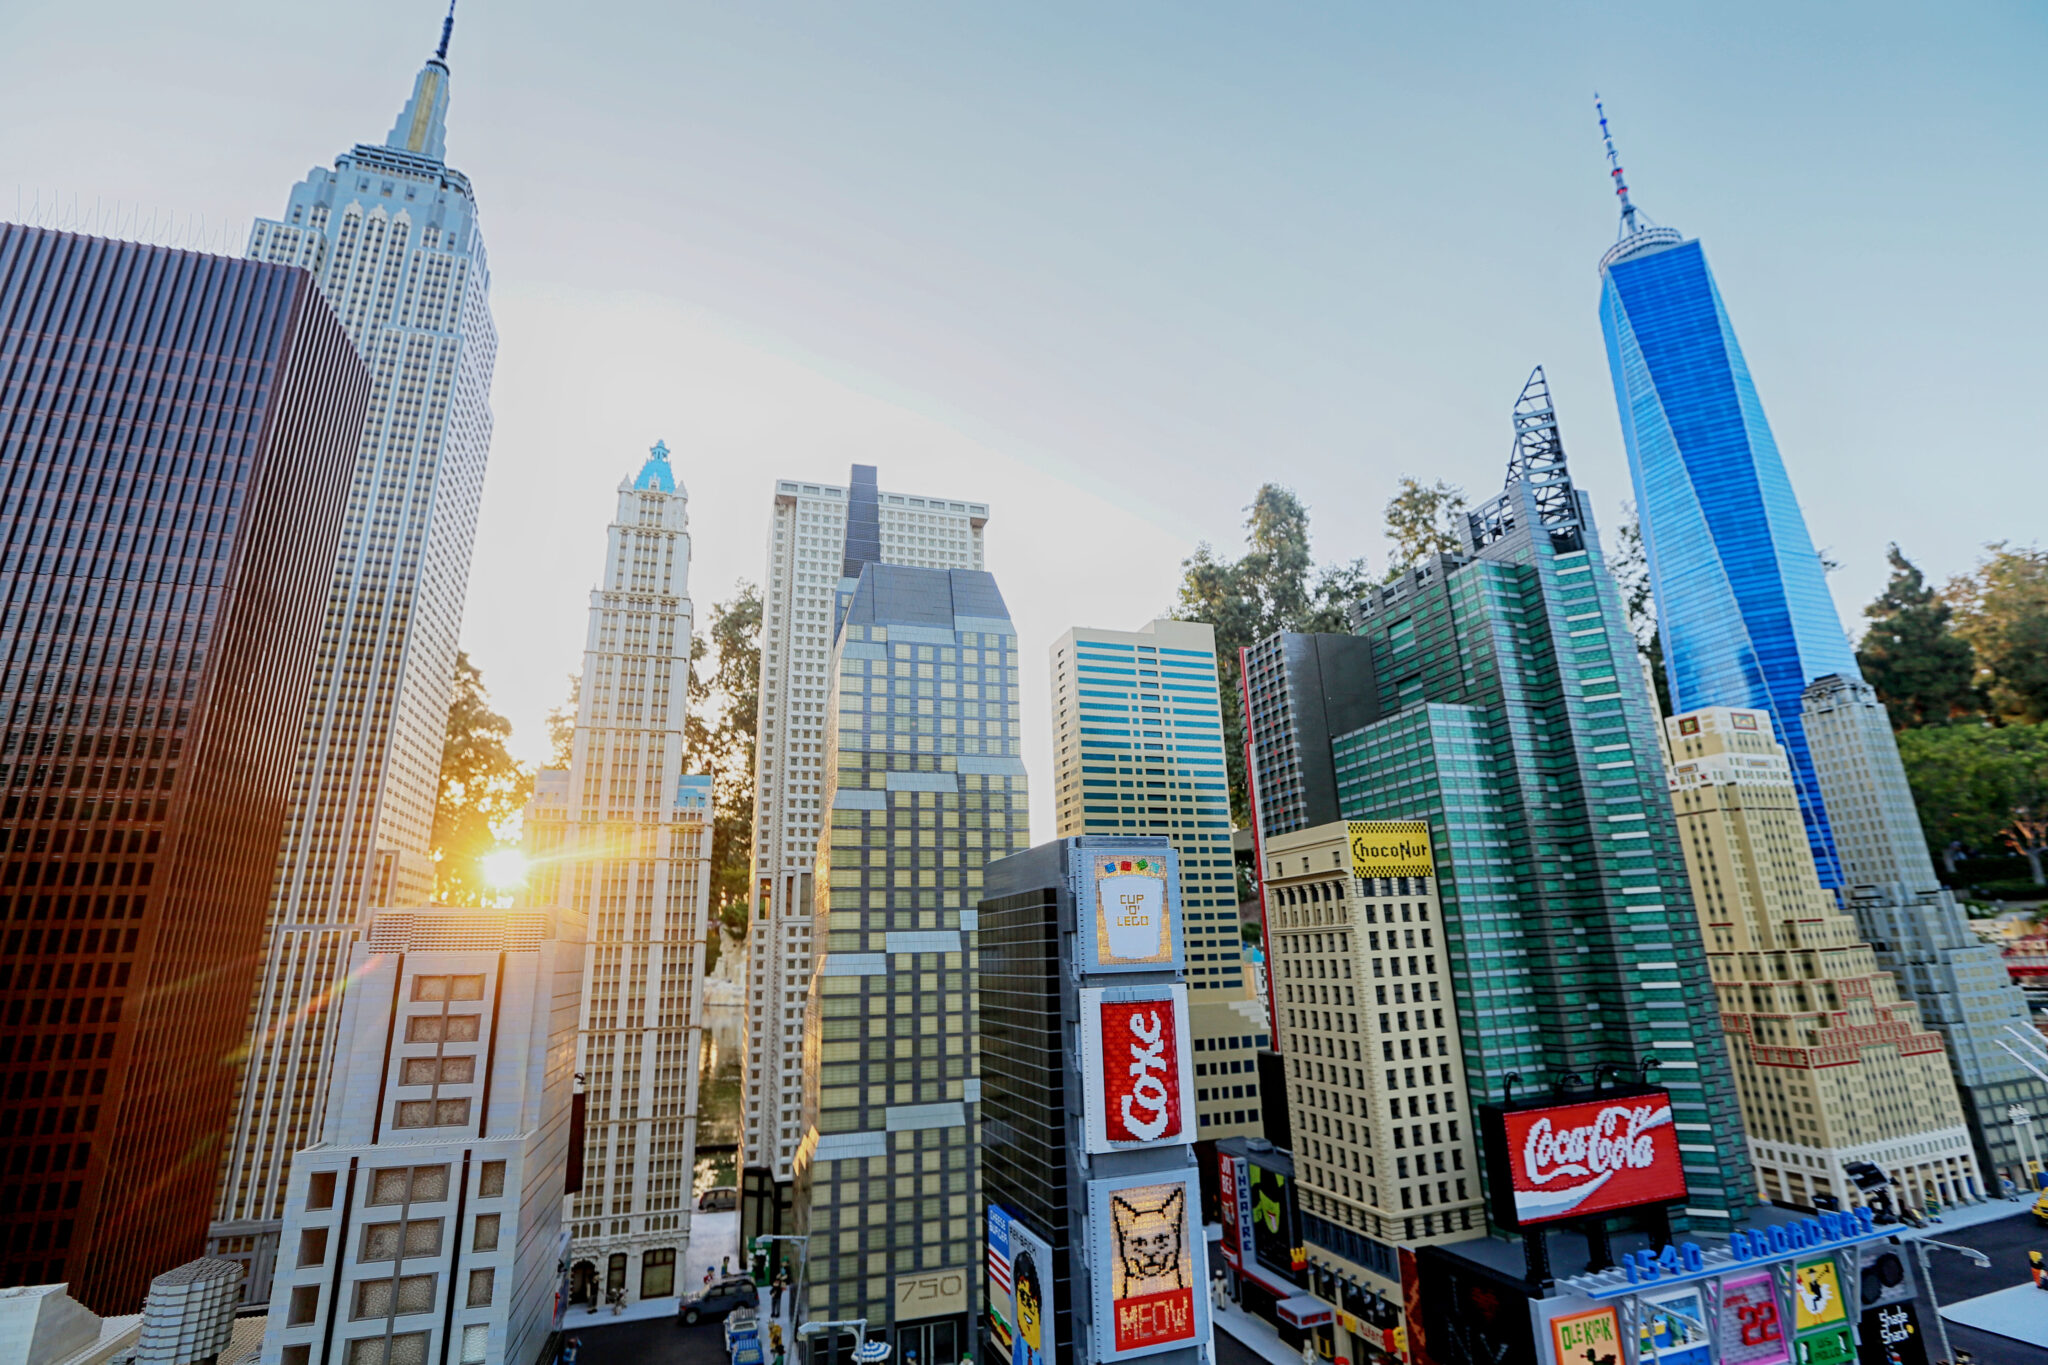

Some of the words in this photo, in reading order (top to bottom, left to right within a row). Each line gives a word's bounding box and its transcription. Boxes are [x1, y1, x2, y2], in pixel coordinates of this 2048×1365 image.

[1353, 837, 1427, 862] ChocoNut
[1120, 894, 1144, 905] CUP
[1117, 916, 1149, 927] LEGO
[1121, 1010, 1168, 1142] Coke
[1237, 1164, 1252, 1251] THEATRE
[1622, 1242, 1703, 1284] 1540
[1730, 1206, 1873, 1261] BROADWAY
[898, 1275, 962, 1303] 750
[1120, 1296, 1188, 1342] MEOW
[1561, 1323, 1583, 1350] OLE
[1738, 1302, 1781, 1346] 22
